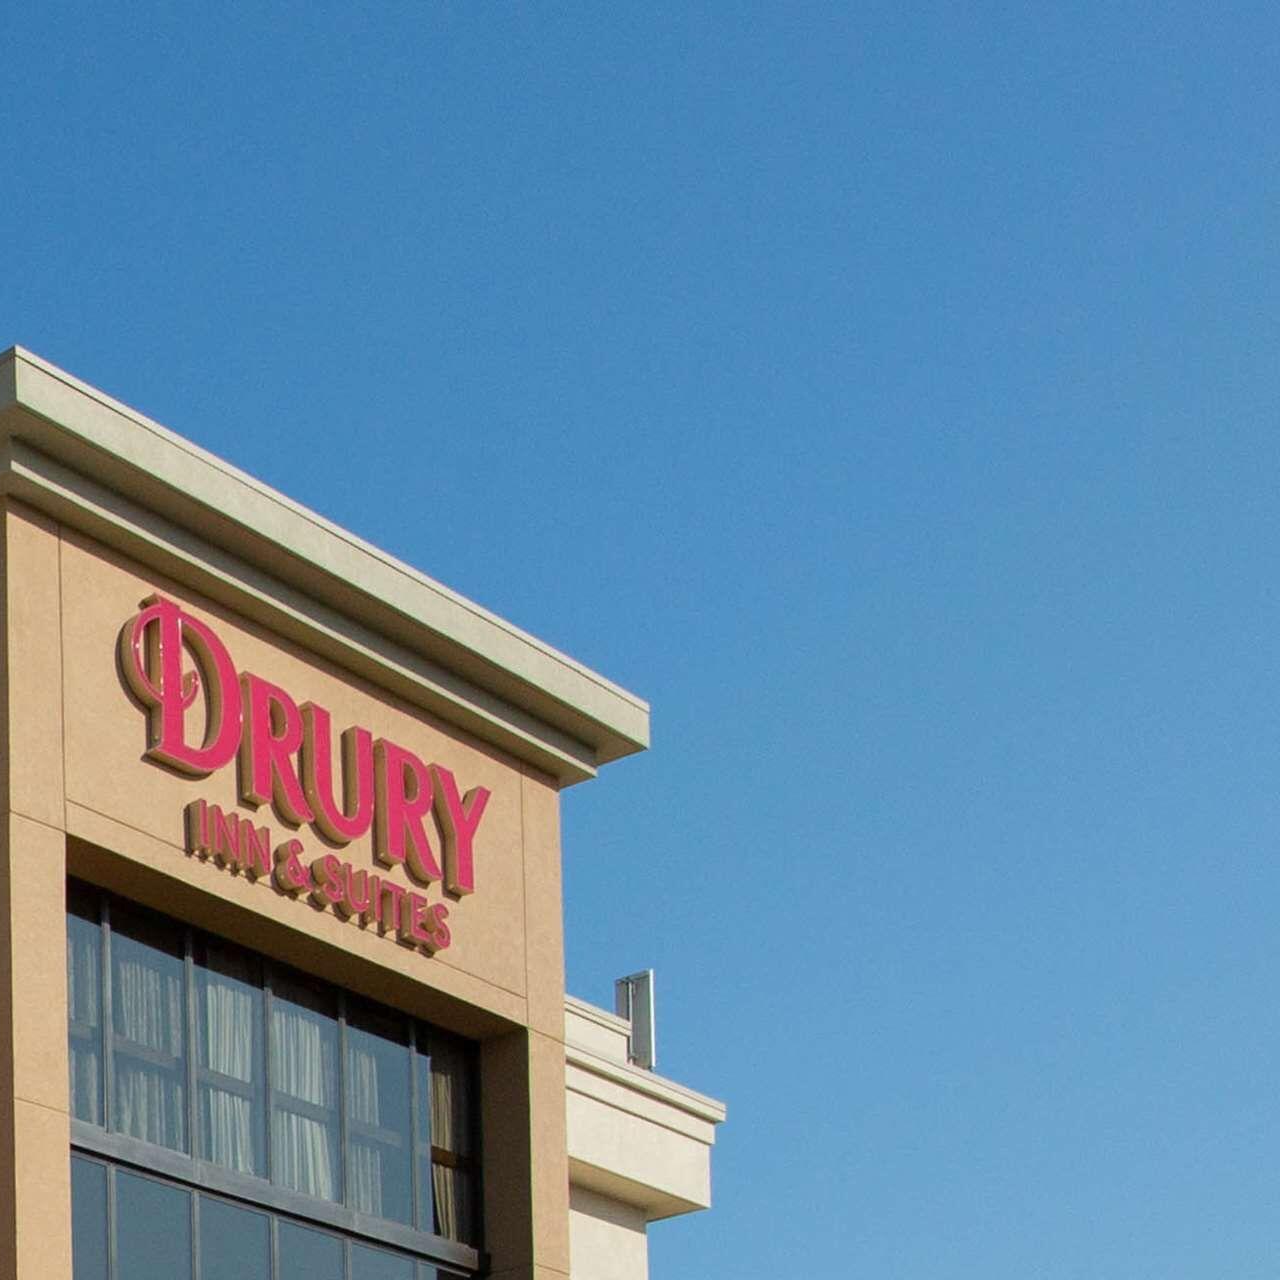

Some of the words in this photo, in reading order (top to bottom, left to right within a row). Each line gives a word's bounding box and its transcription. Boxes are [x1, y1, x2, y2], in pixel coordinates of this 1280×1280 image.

[122, 594, 491, 898] DRURY
[186, 799, 270, 880] INN
[273, 839, 313, 898] &
[309, 854, 450, 955] SUITES
